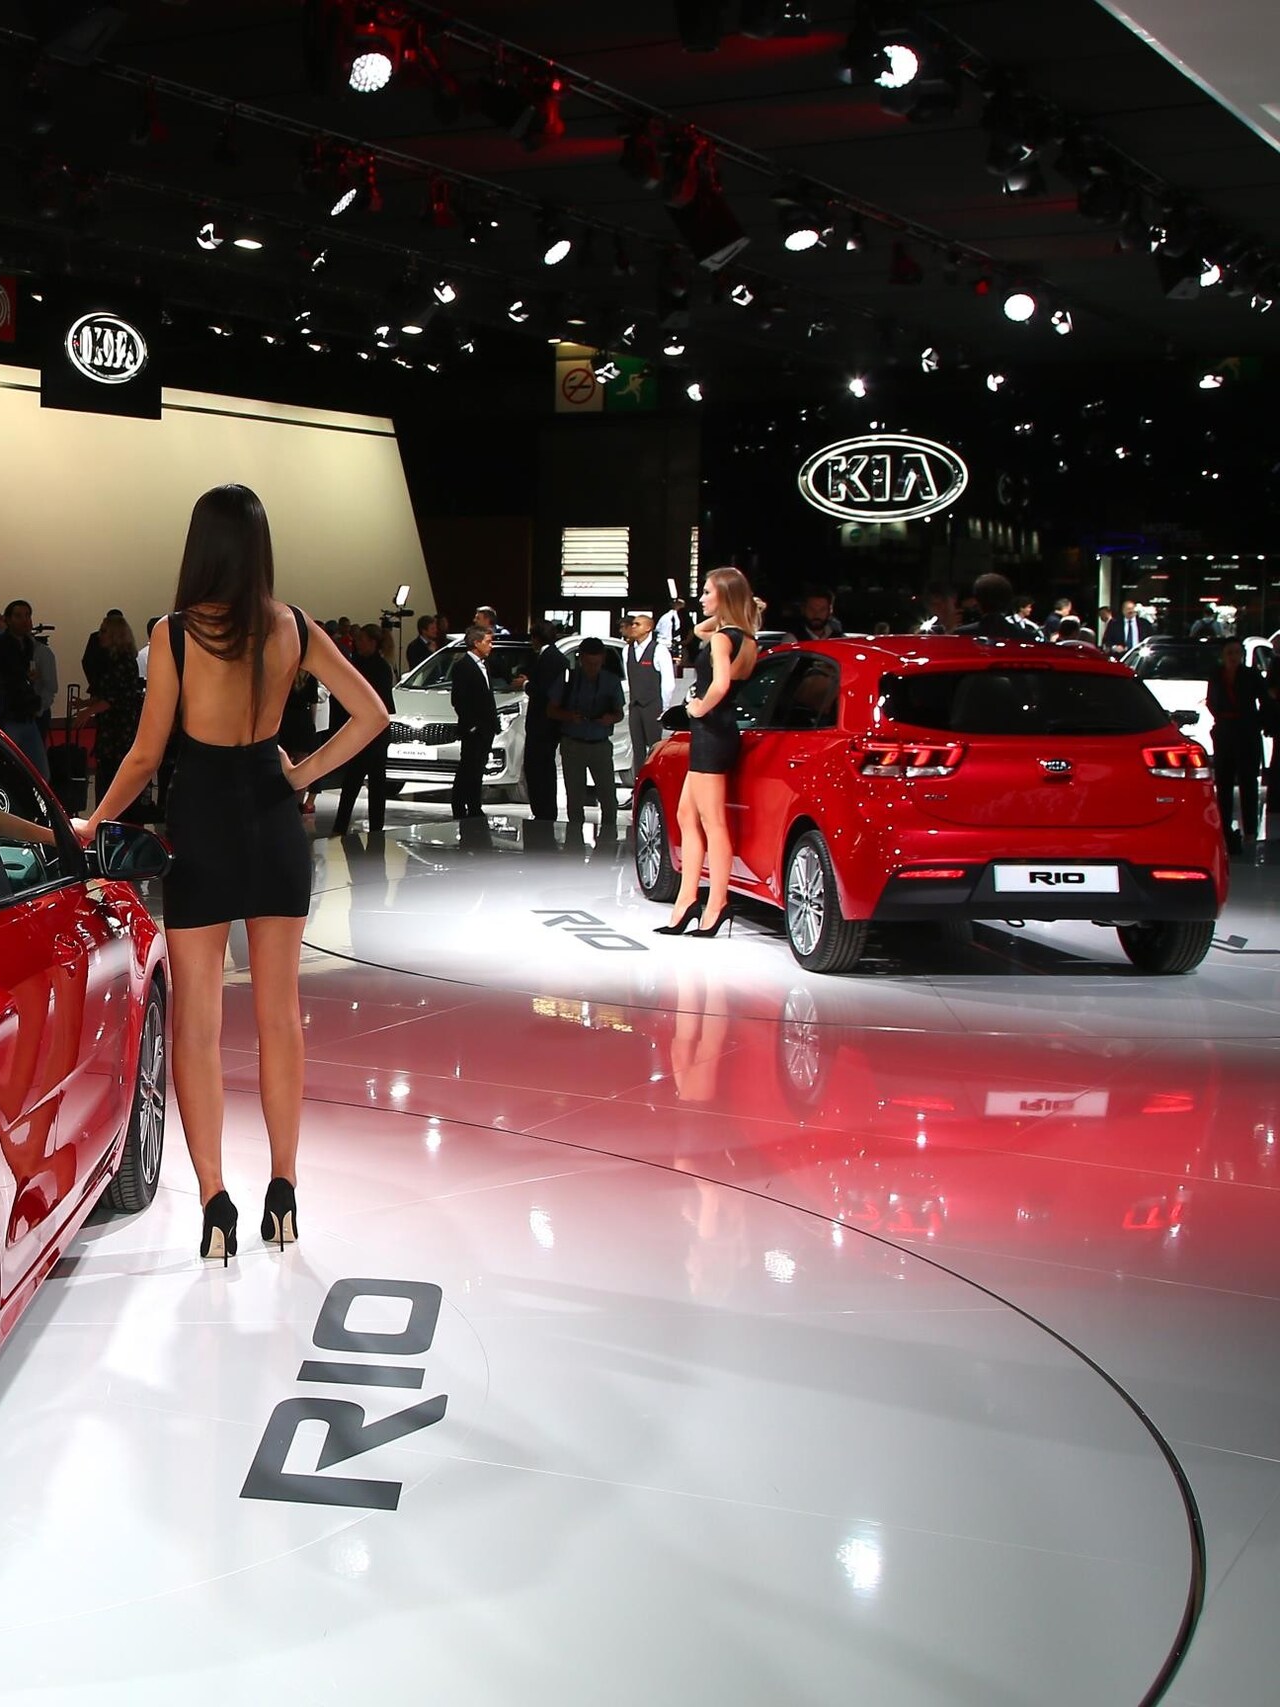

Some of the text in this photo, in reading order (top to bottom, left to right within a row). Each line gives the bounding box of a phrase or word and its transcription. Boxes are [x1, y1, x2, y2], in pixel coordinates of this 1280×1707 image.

[828, 453, 938, 501] KIA
[1029, 871, 1085, 885] RIO
[530, 909, 650, 951] RIO
[239, 1278, 448, 1511] RIO
